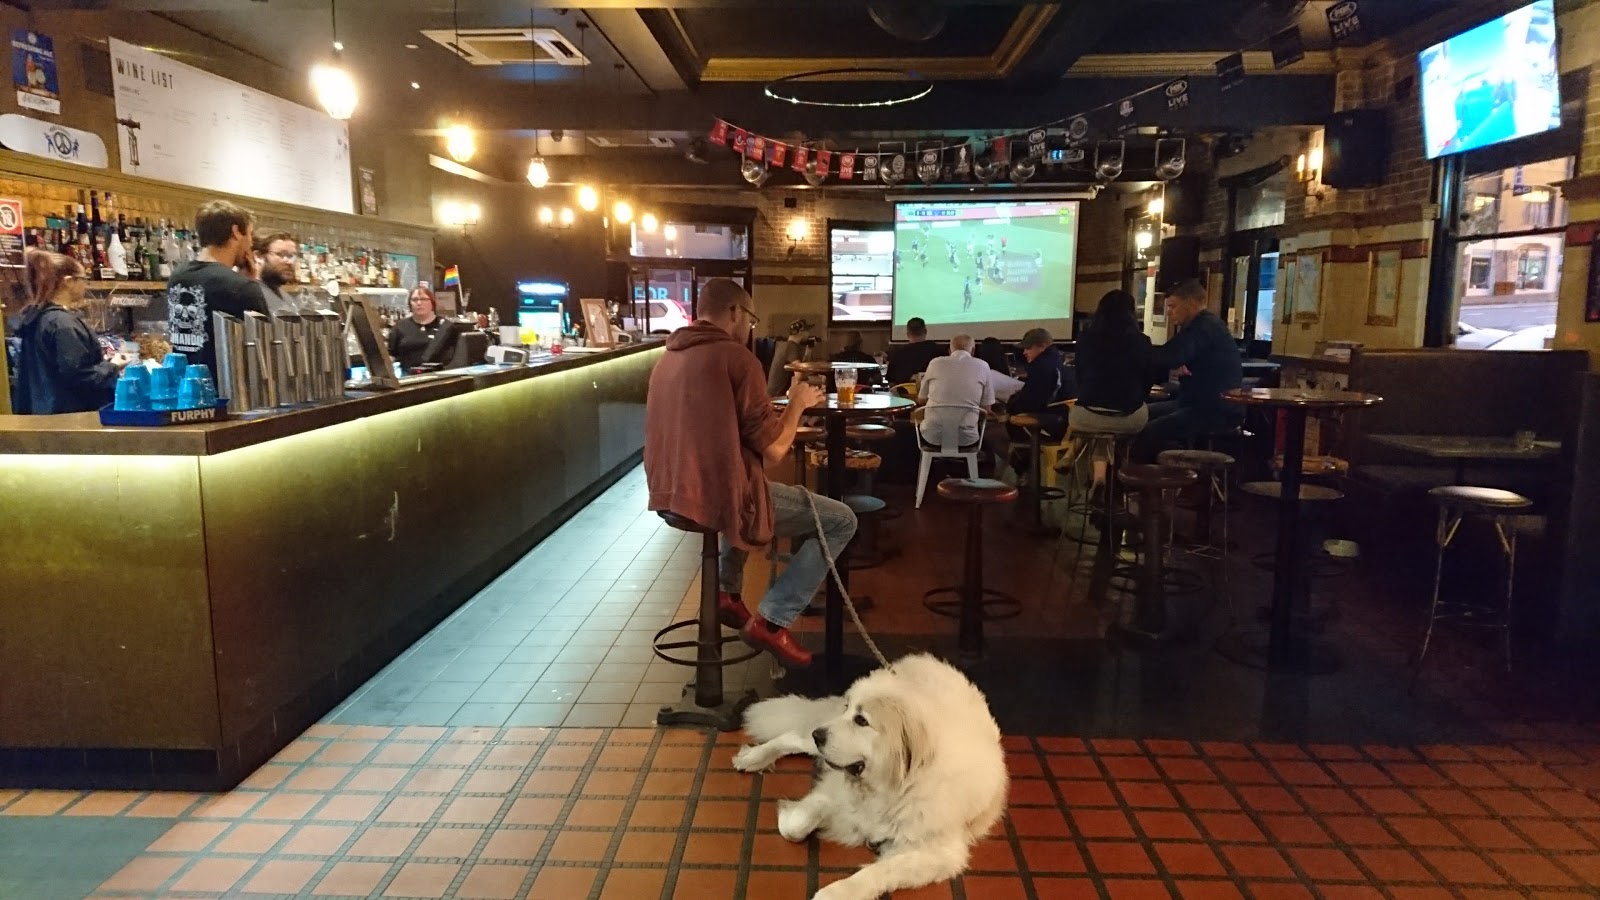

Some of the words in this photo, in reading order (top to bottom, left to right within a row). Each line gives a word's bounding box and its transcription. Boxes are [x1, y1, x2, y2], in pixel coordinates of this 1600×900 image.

[1333, 15, 1360, 34] LIVE
[116, 58, 146, 81] WINE
[151, 69, 174, 89] LIST
[1168, 93, 1188, 107] LIVE
[1030, 142, 1046, 152] LIVE
[634, 286, 668, 300] FOR
[171, 408, 215, 422] FURPHY
